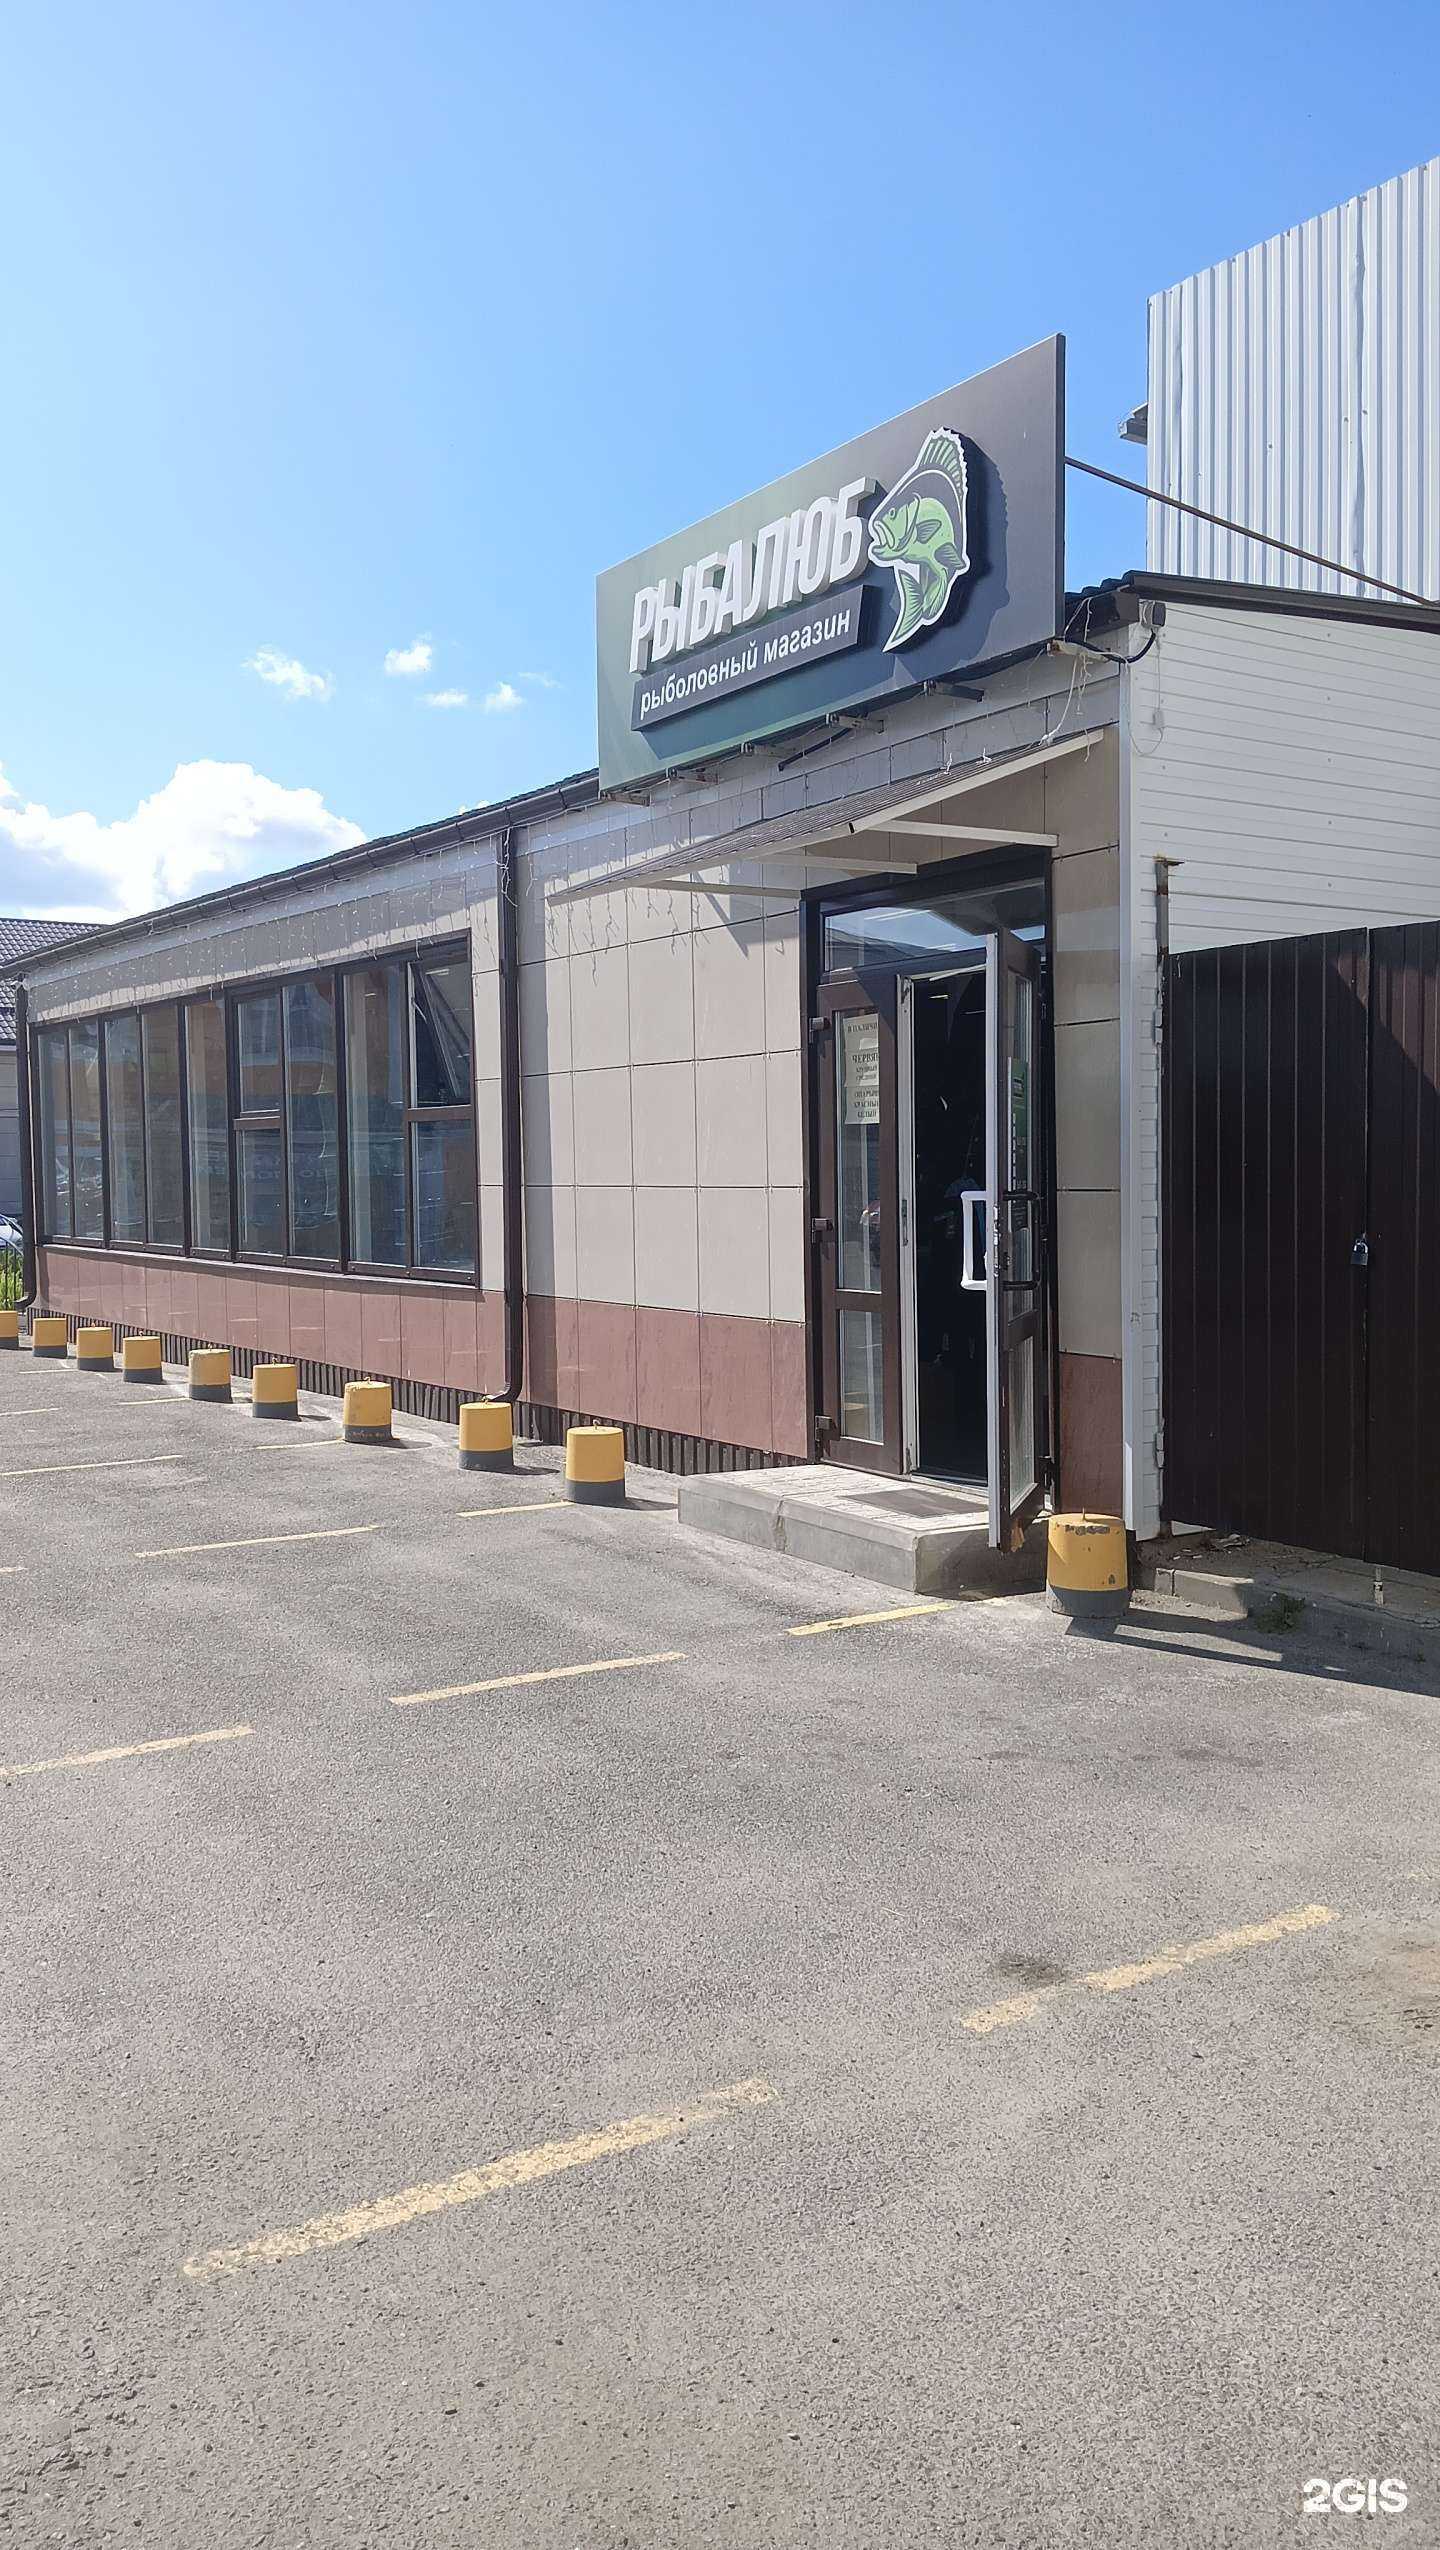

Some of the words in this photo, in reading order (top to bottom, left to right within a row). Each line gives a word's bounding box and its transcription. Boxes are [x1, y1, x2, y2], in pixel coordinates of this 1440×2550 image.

[630, 477, 869, 673] РЫБАЛЮБ
[640, 640, 758, 720] рыболовный
[763, 609, 850, 665] магазин
